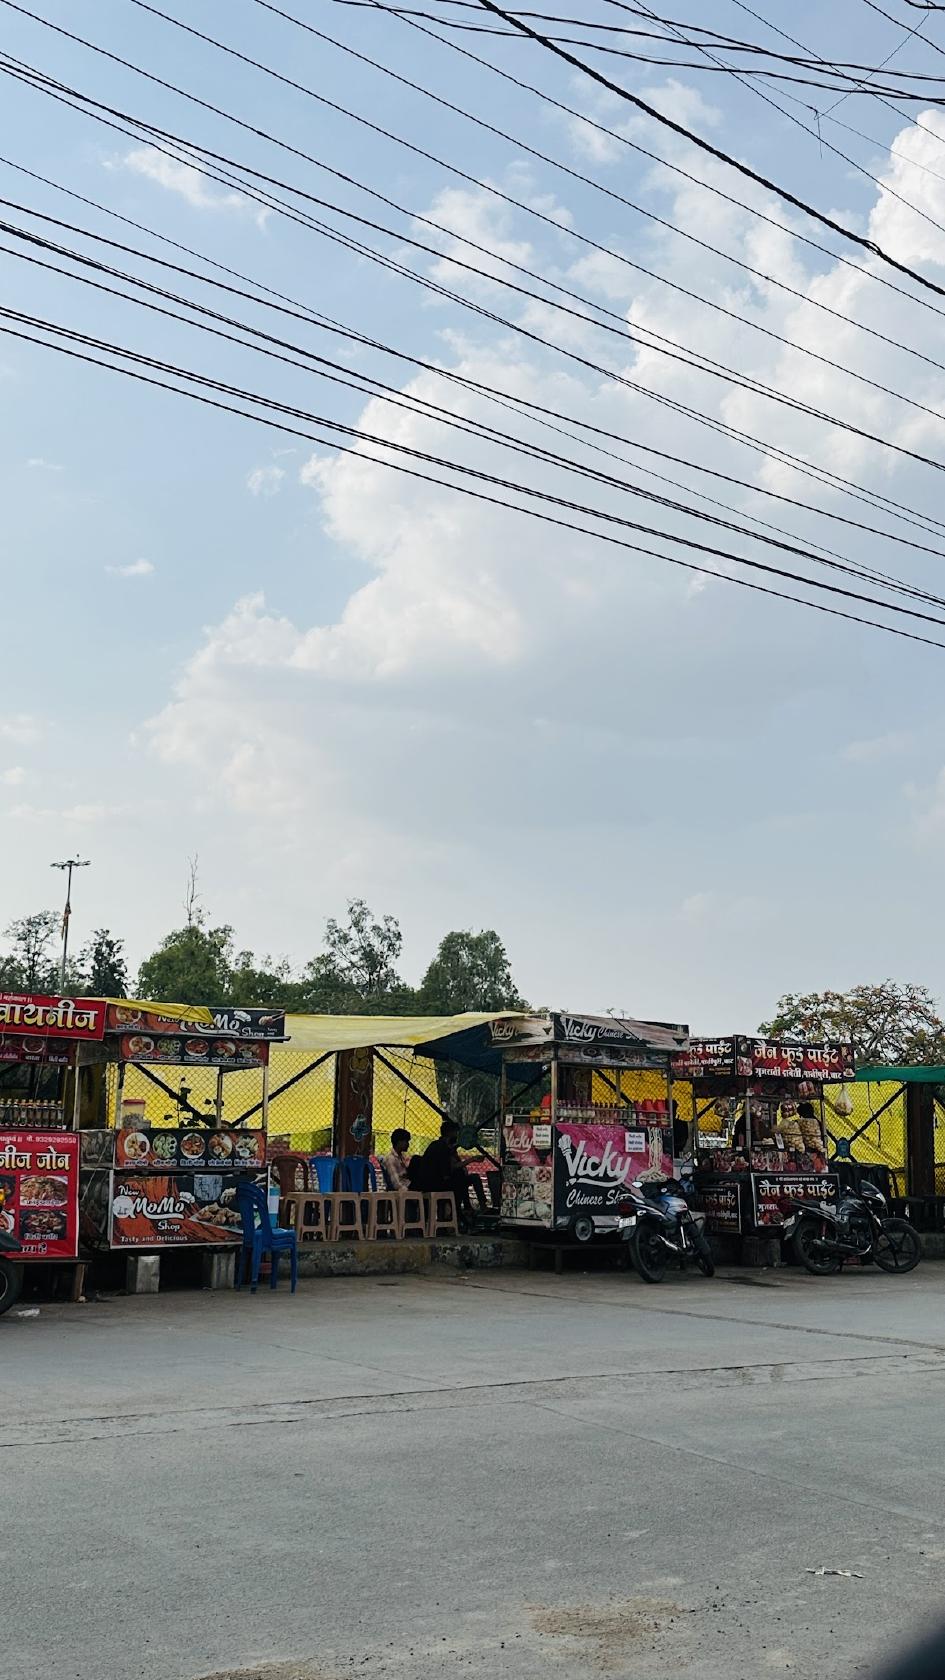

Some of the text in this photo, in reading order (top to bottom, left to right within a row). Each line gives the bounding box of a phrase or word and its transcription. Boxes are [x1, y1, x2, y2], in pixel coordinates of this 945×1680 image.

[489, 1021, 516, 1041] Vicky
[561, 1017, 598, 1042] Vicky
[597, 1026, 624, 1039] Chinese
[754, 1040, 778, 1060] जैन
[781, 1046, 804, 1066] फूड
[504, 1129, 533, 1153] Vicky
[36, 1145, 71, 1170] जोन
[563, 1138, 631, 1187] Vicky
[119, 1185, 139, 1196] New
[566, 1188, 603, 1207] Chinese
[759, 1180, 780, 1197] जैन
[132, 1197, 184, 1219] MoMo
[158, 1221, 180, 1231] Shop
